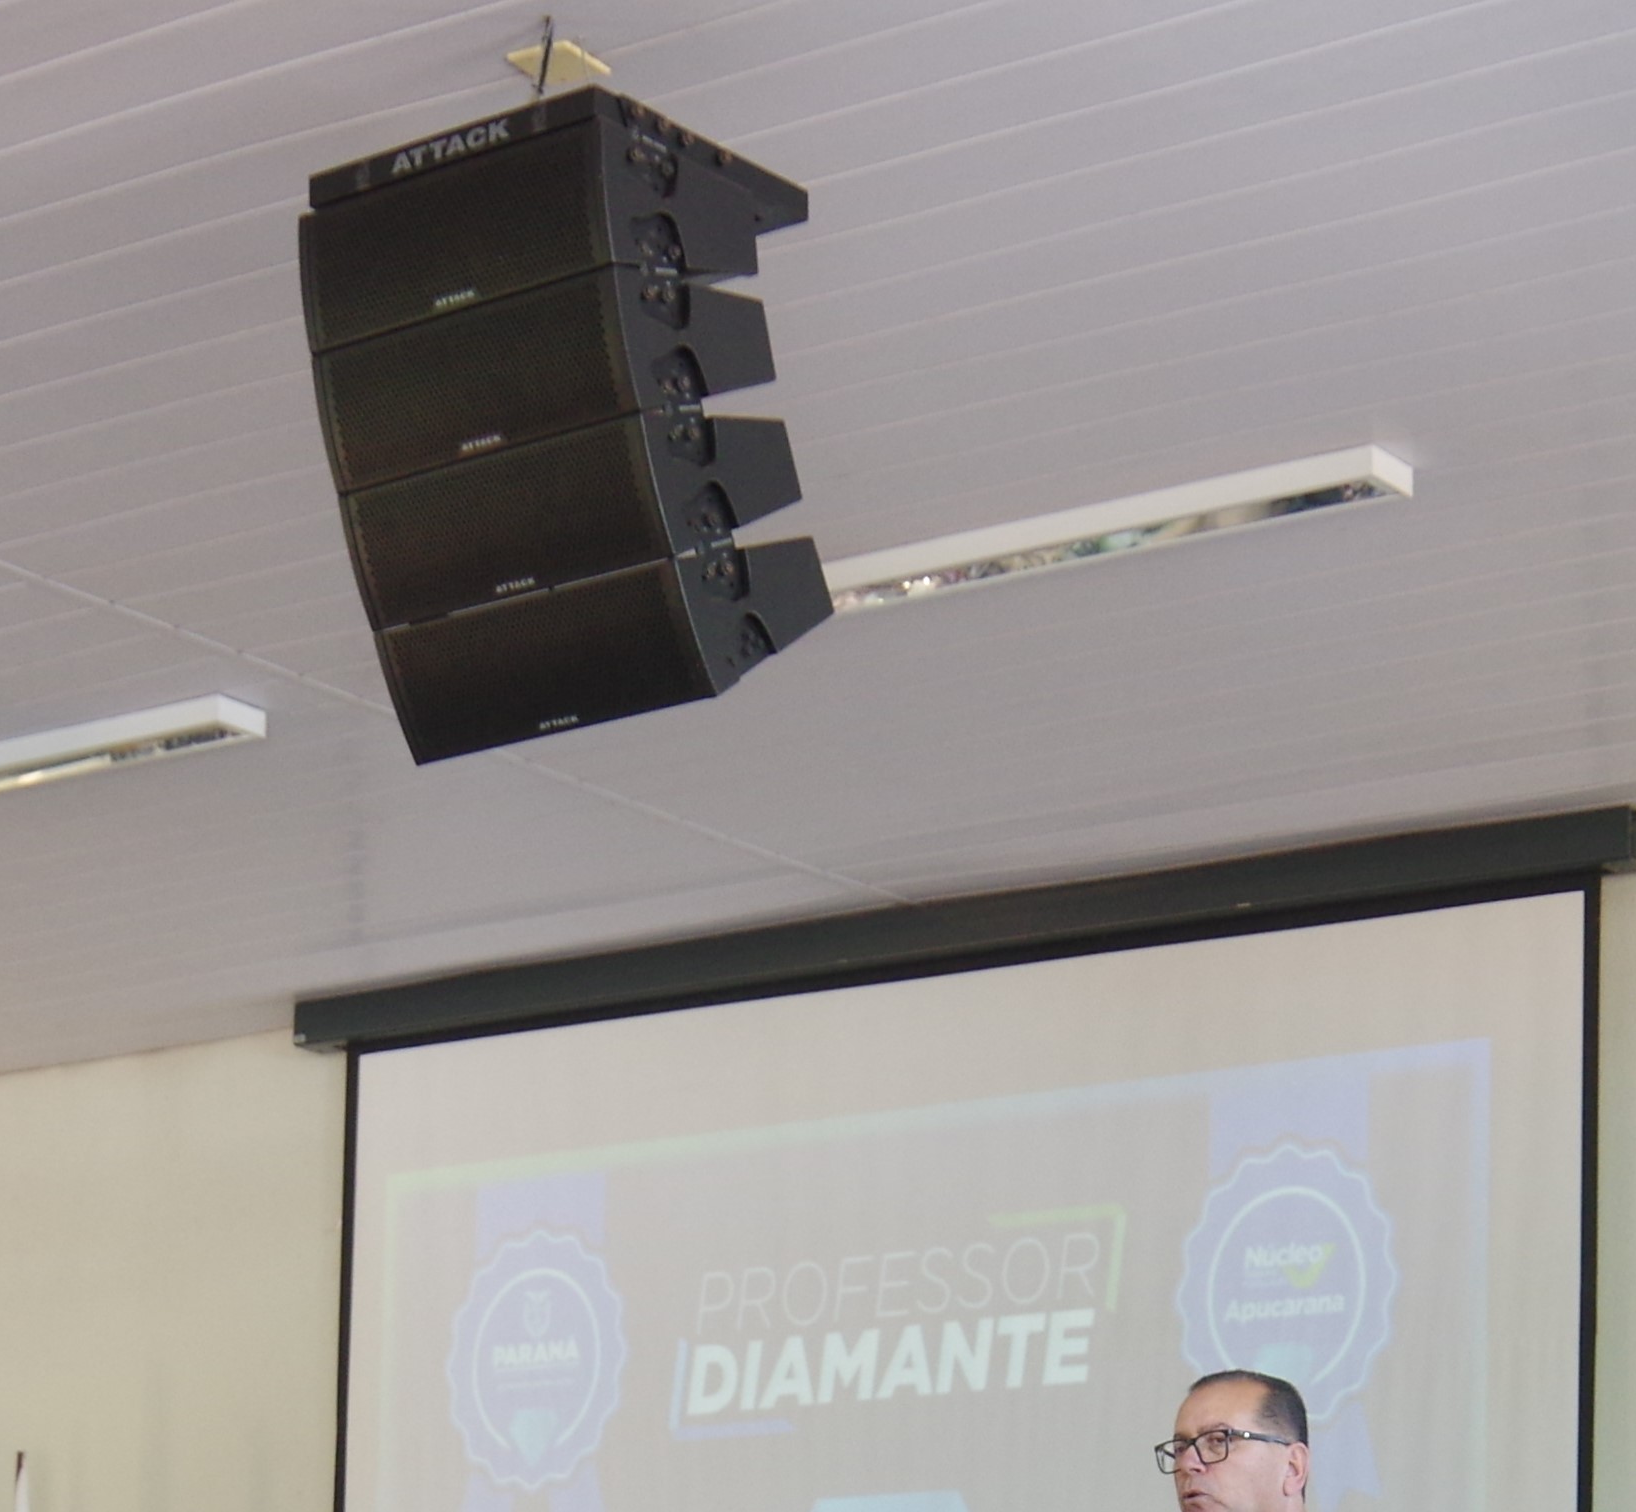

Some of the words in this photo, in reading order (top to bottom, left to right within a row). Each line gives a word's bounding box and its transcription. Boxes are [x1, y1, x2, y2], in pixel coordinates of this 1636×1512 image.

[391, 118, 511, 174] ATTACK
[495, 576, 536, 594] ATTACK
[538, 714, 580, 731] ATTACK
[696, 1231, 1101, 1335] PROFESSOR
[1224, 1293, 1346, 1324] Apucarana
[686, 1307, 1096, 1416] DIAMANTE
